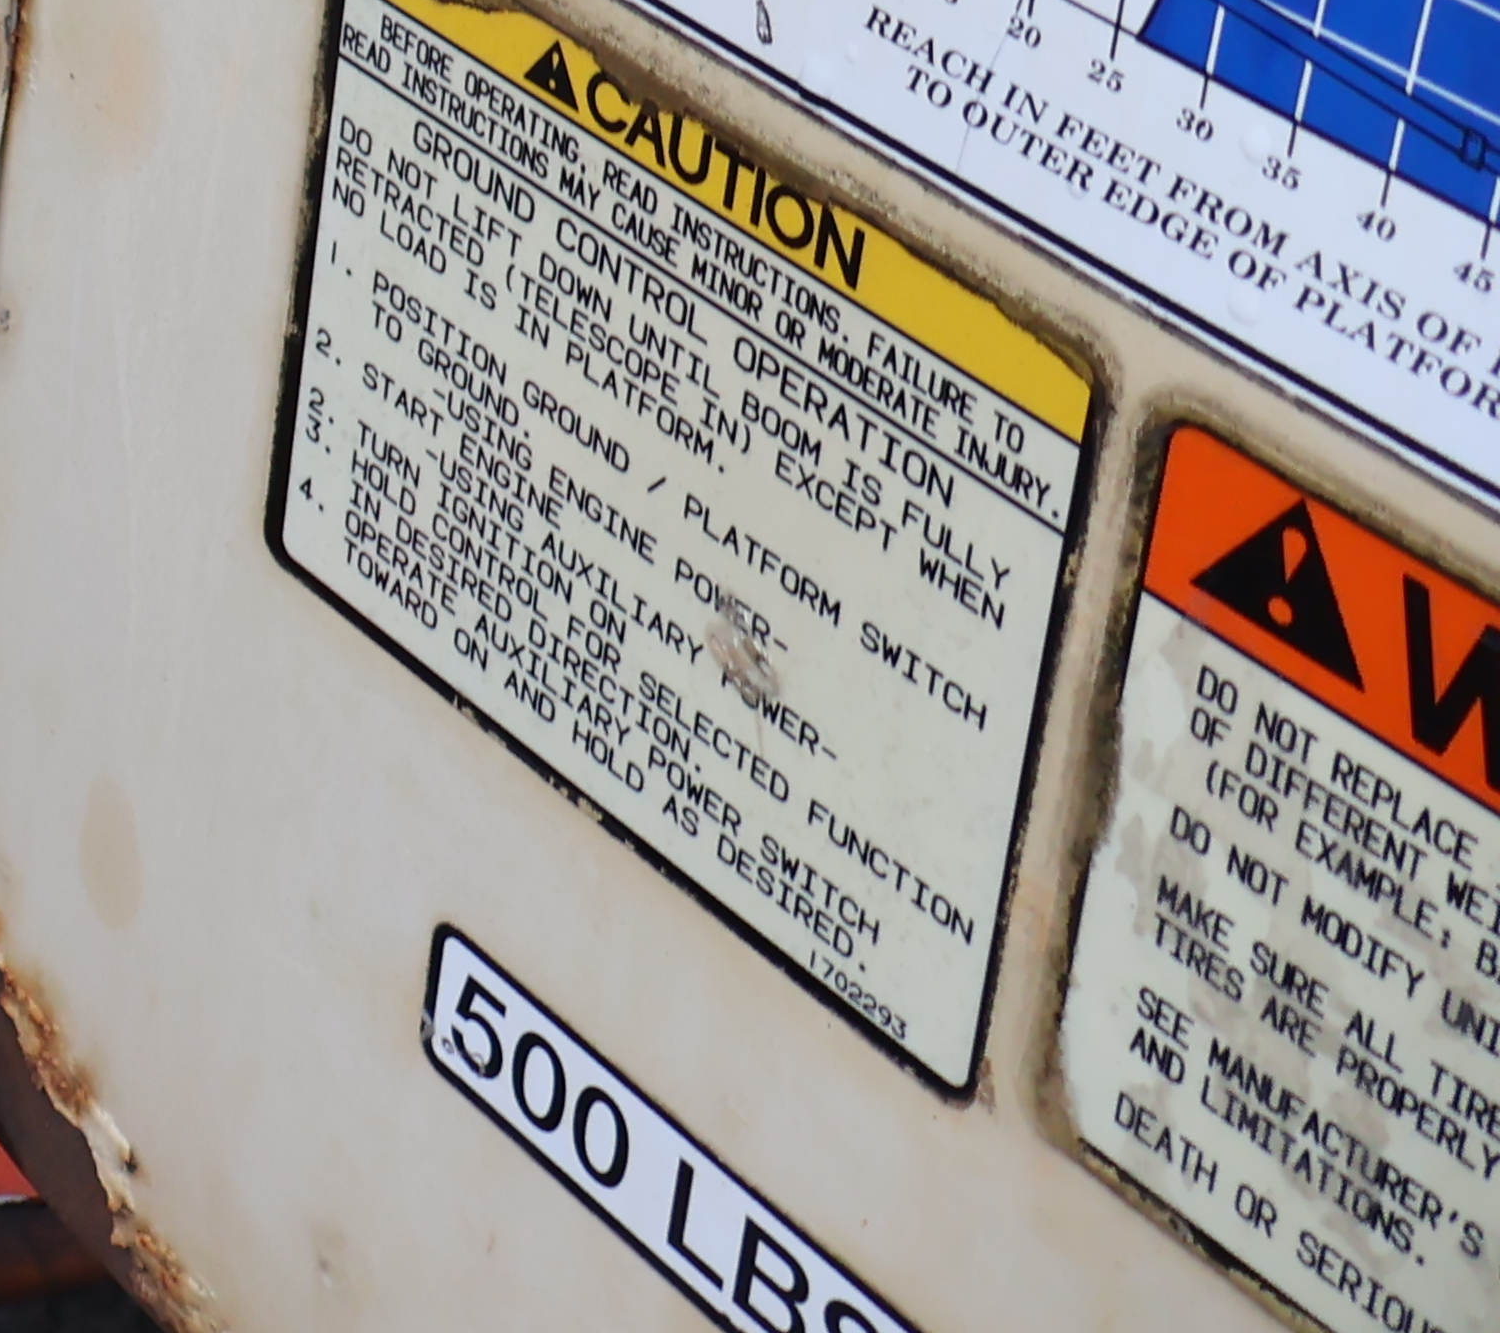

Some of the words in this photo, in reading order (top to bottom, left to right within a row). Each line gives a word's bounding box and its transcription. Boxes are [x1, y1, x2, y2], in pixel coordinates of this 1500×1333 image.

[381, 14, 453, 83] BEFORE
[1007, 15, 1043, 50] 20
[340, 115, 373, 156] DO
[388, 149, 438, 200] NOT
[453, 194, 522, 257] LIFT
[539, 252, 613, 323] DOWN
[343, 23, 390, 74] READ
[401, 64, 549, 180] INSTRUCTIONS
[560, 168, 600, 211] MAY
[611, 203, 681, 268] CAUSE
[588, 73, 866, 290] CAUTION
[864, 6, 995, 97] REACH
[999, 82, 1051, 125] IN
[1052, 111, 1162, 182] FEET
[1166, 167, 1291, 257] FROM
[1294, 242, 1409, 323] AXIS
[1414, 305, 1482, 361] OF
[906, 64, 951, 108] TO
[961, 100, 1093, 193] OUTER
[1102, 179, 1216, 263] EDGE
[1225, 245, 1288, 300] OF
[413, 121, 535, 223] GROUND
[556, 218, 708, 345] CONTROL
[733, 337, 954, 508] OPERATION
[1196, 664, 1239, 716] DO
[1255, 701, 1318, 765] NOT
[1331, 752, 1479, 870] REPLACE
[807, 950, 907, 1039] 1702293
[1170, 804, 1211, 856] DO
[1227, 845, 1290, 907] NOT
[1300, 895, 1426, 1001] MODIFY
[450, 973, 630, 1189] 500
